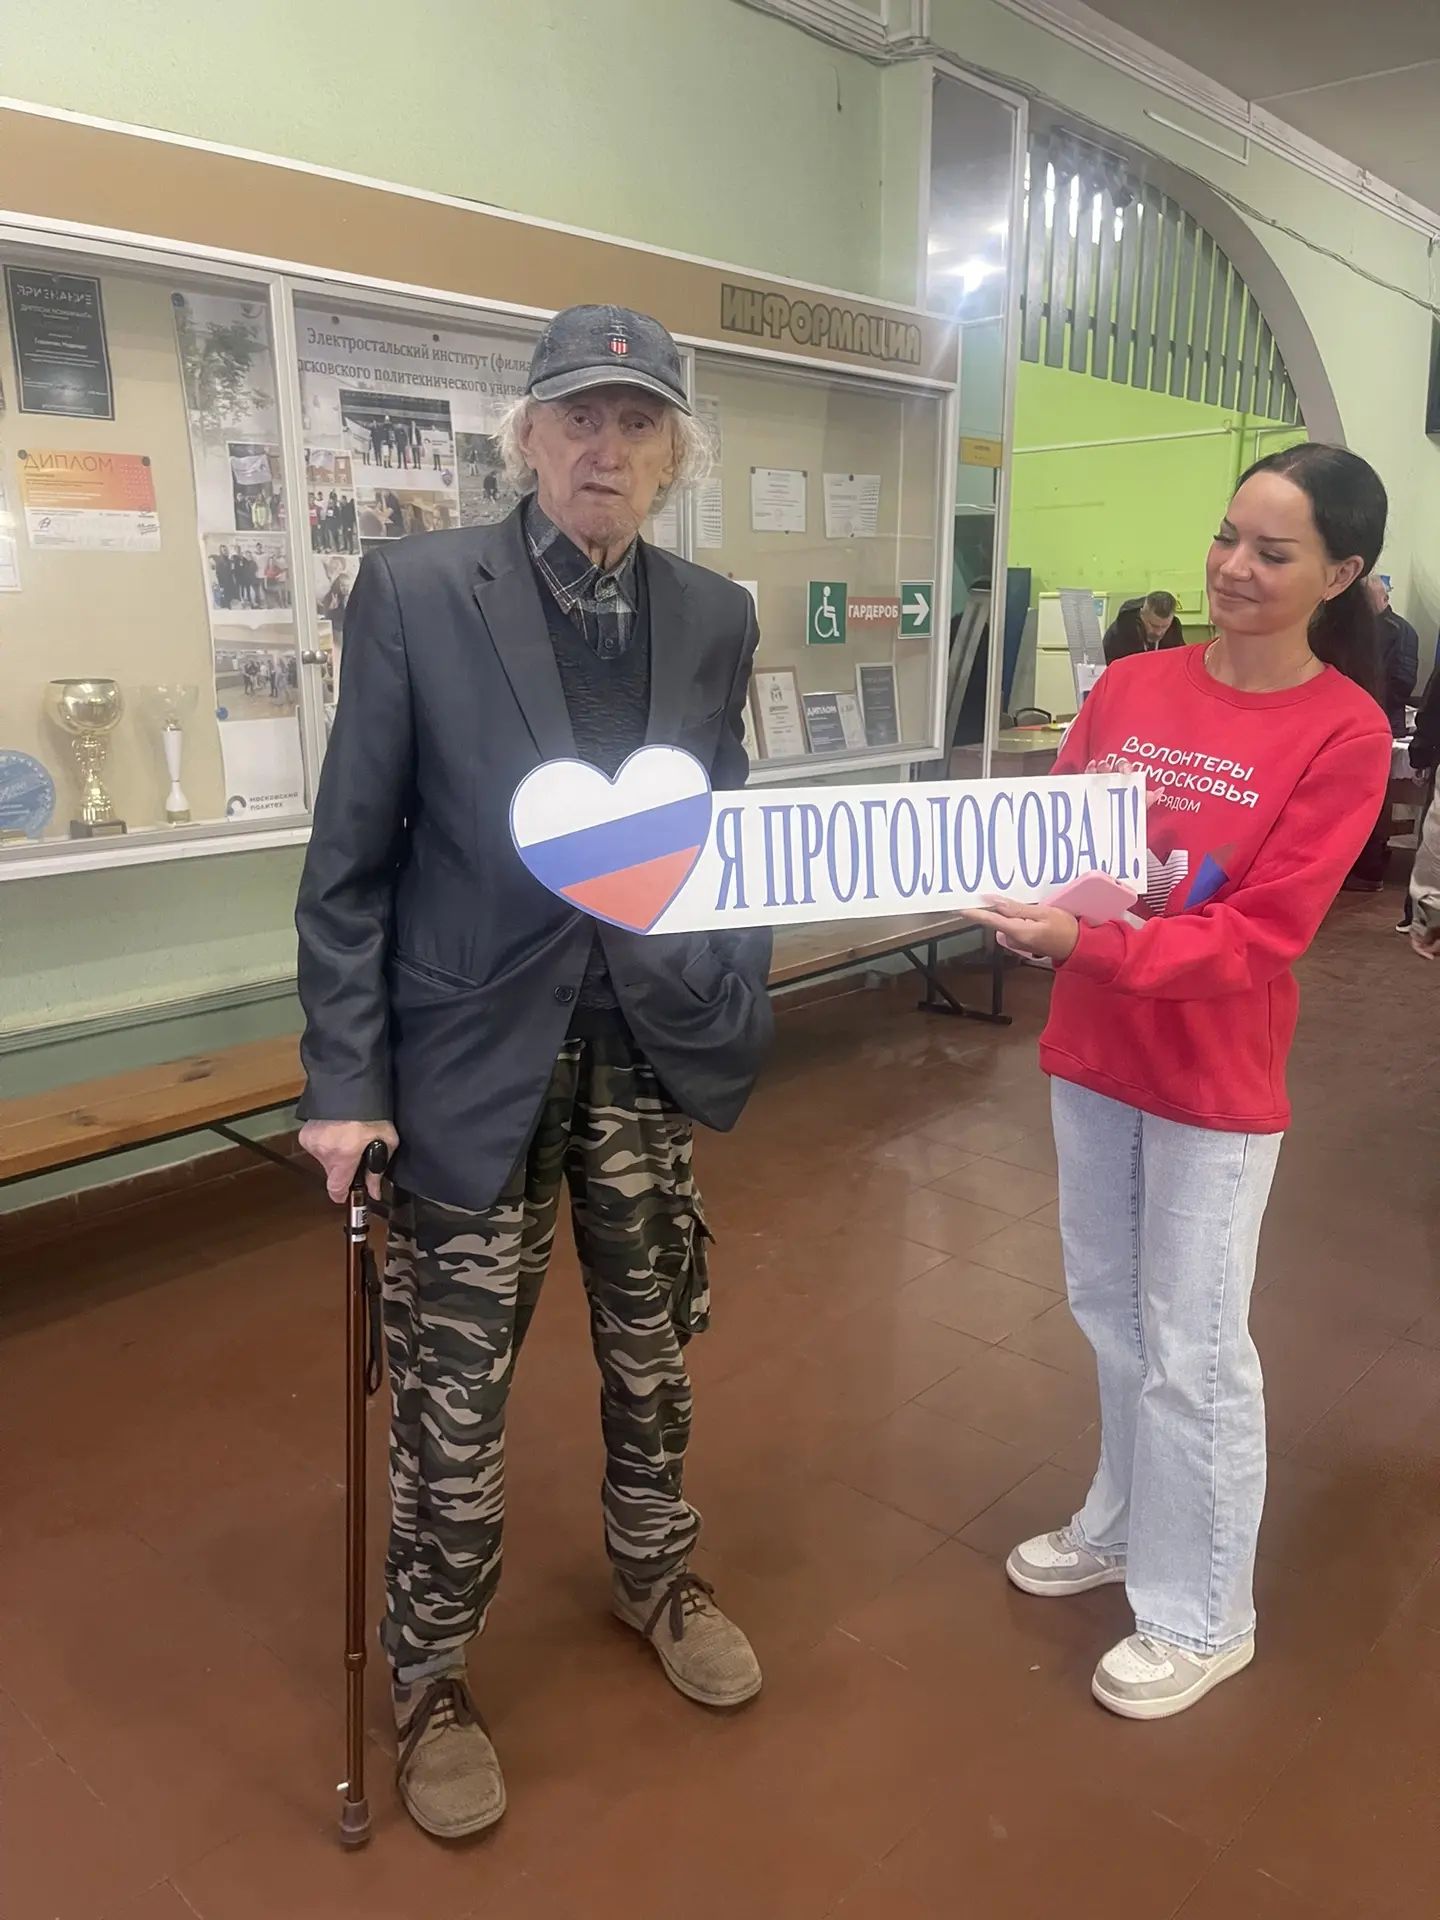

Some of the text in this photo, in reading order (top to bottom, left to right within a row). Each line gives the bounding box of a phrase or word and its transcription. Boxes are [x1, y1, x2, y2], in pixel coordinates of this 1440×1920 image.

[721, 283, 921, 365] ИНФОРМАЦИЯ
[306, 327, 429, 359] Электростальский
[432, 349, 488, 370] институт
[374, 368, 487, 393] политехнического
[23, 453, 113, 473] ДИПЛОМ
[848, 604, 899, 619] ГАРДЕРОБ
[1121, 736, 1255, 781] ВОЛОНТЕРЫ
[714, 785, 1140, 911] Я ПРОГОЛОСОВАЛ!
